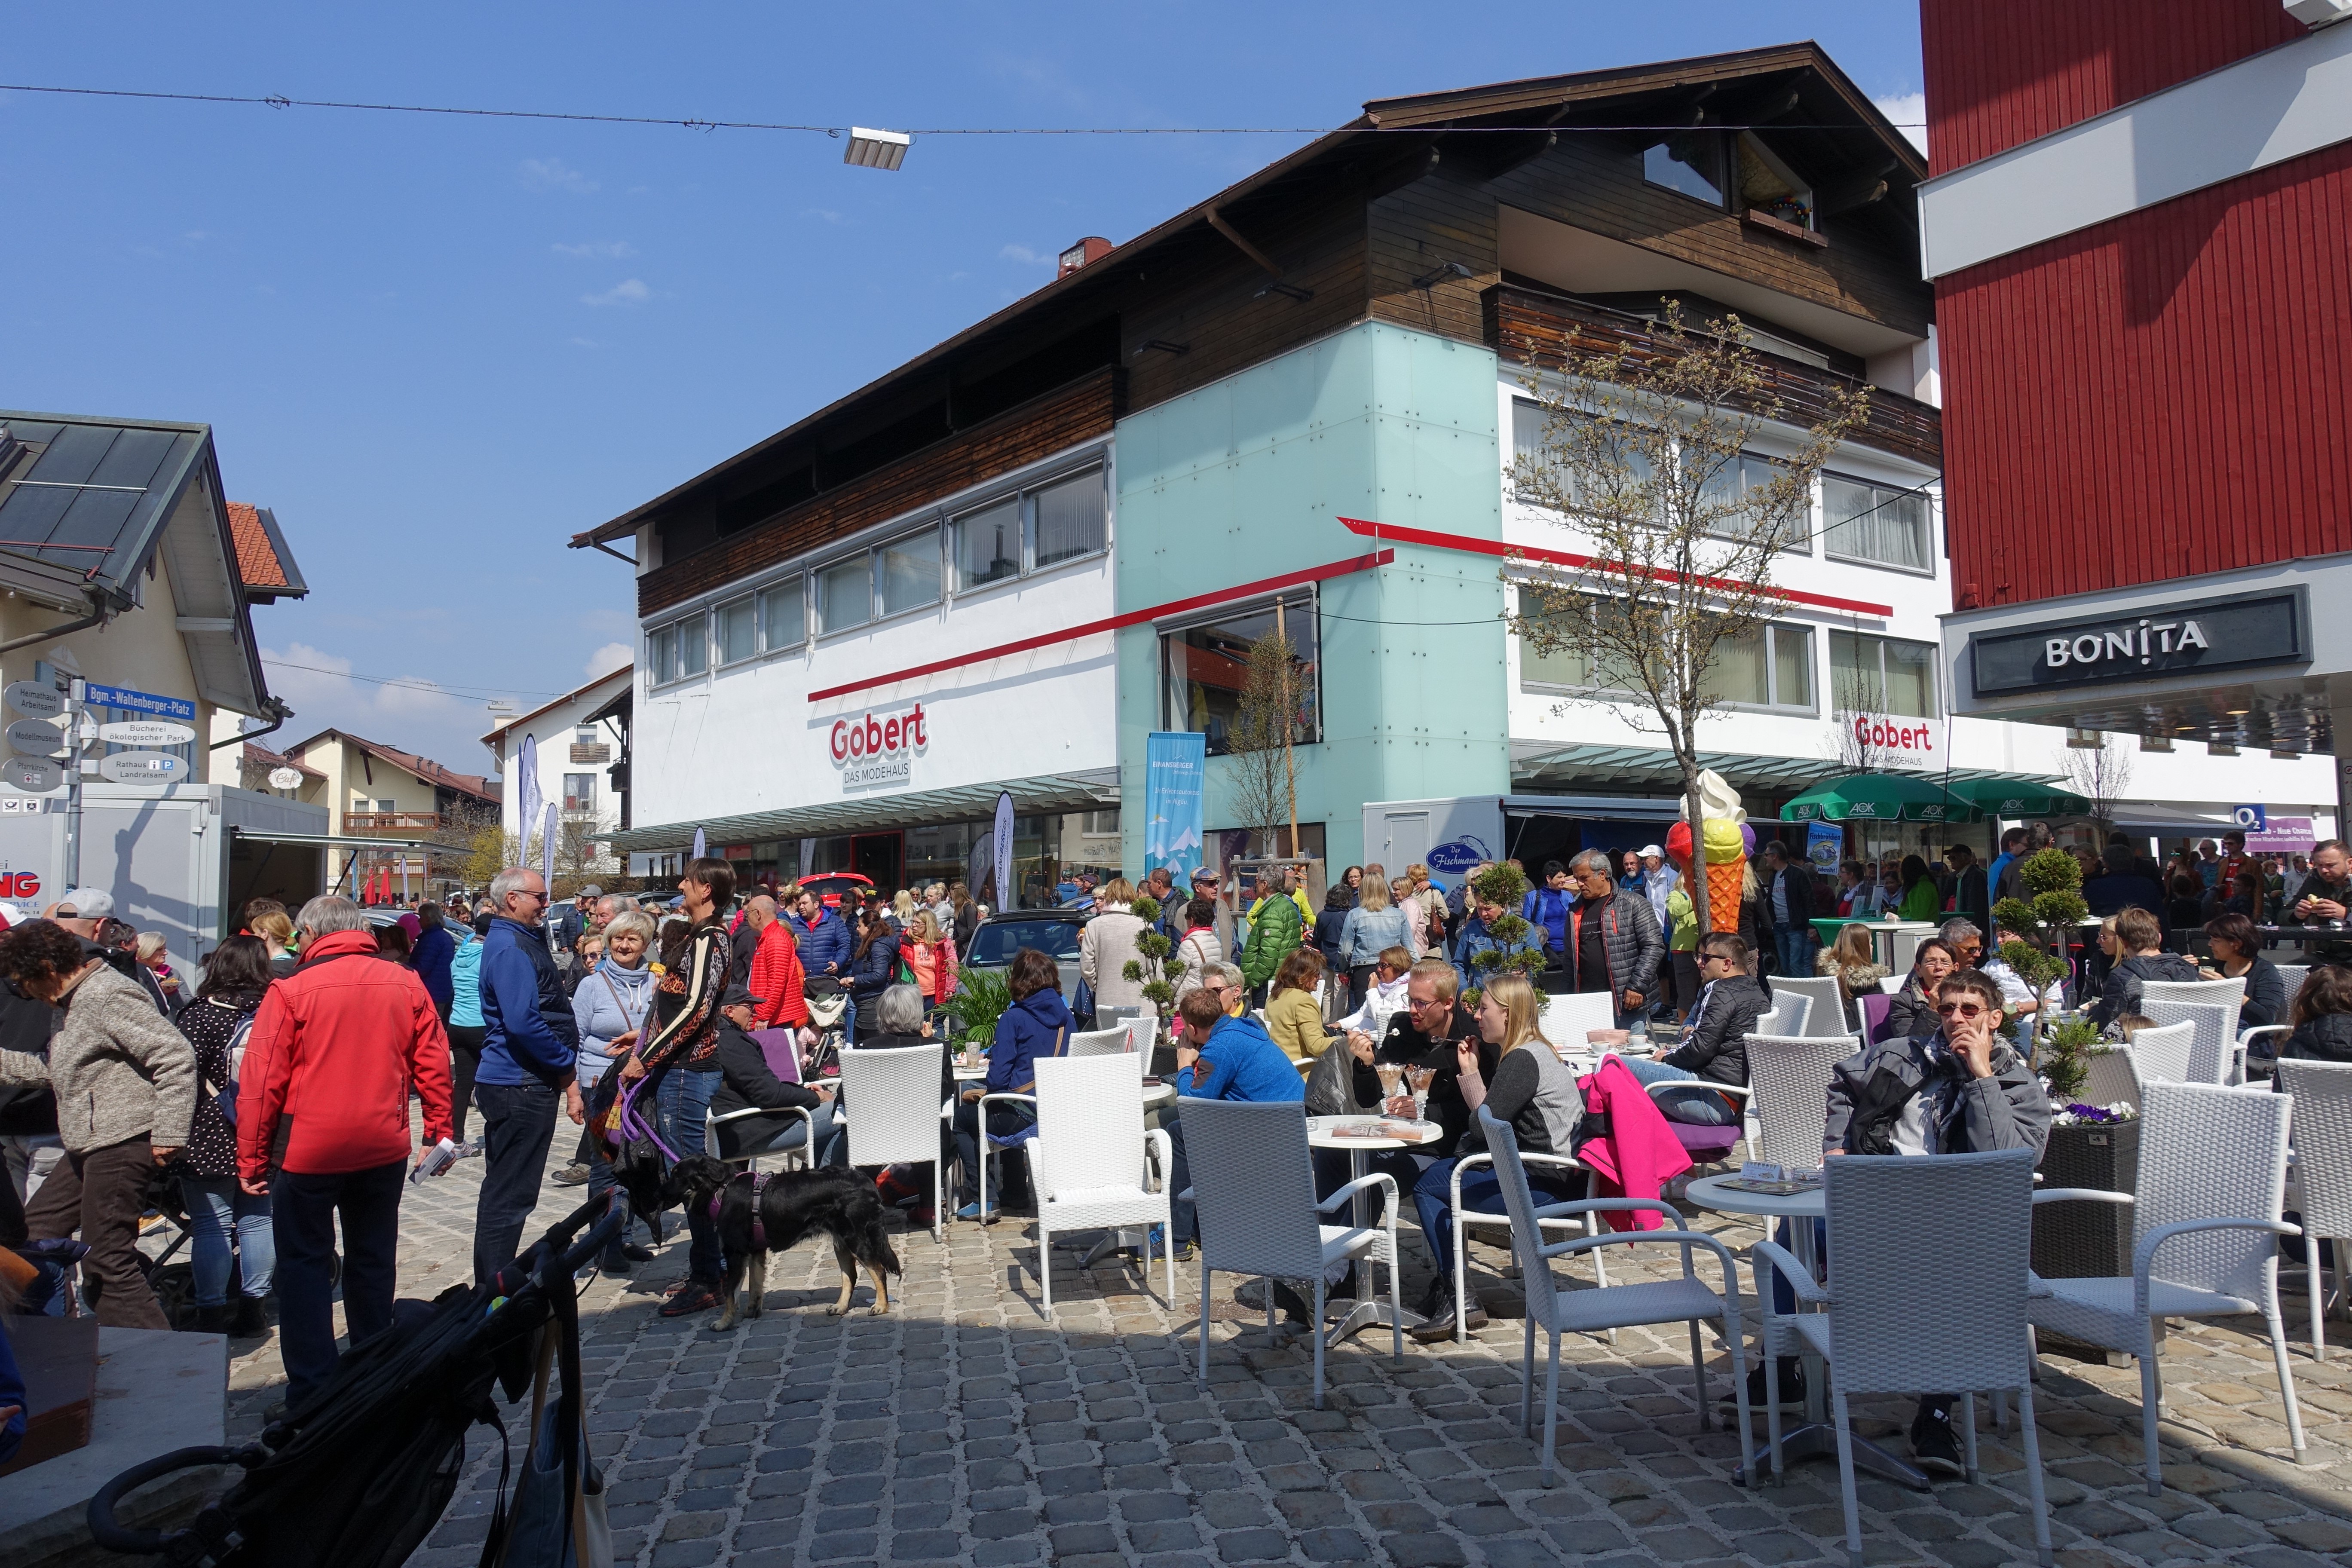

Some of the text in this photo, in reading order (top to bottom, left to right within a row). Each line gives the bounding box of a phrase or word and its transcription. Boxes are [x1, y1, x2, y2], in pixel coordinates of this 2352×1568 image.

[2046, 619, 2209, 667] BONITA
[20, 688, 57, 702] Heimathaus
[21, 700, 56, 712] Arbeitsamt
[90, 687, 190, 716] Bgm.-Waltenberger-Platz
[15, 732, 61, 743] Modellmuseum
[109, 732, 163, 742] ökologischer
[831, 703, 927, 760] Gobert
[1855, 716, 1932, 751] Gobert
[1871, 754, 1922, 766] DAS MODEHAUS
[18, 762, 49, 772] Pfarrkirche
[844, 763, 909, 784] DAS MODEHAUS
[1849, 802, 1875, 813] AOK
[1921, 805, 1945, 815] AOK
[2000, 799, 2024, 809] AOK
[1798, 805, 1810, 816] AOK
[1809, 832, 1841, 840] Fischbrötchen
[1434, 854, 1479, 868] Fischmann
